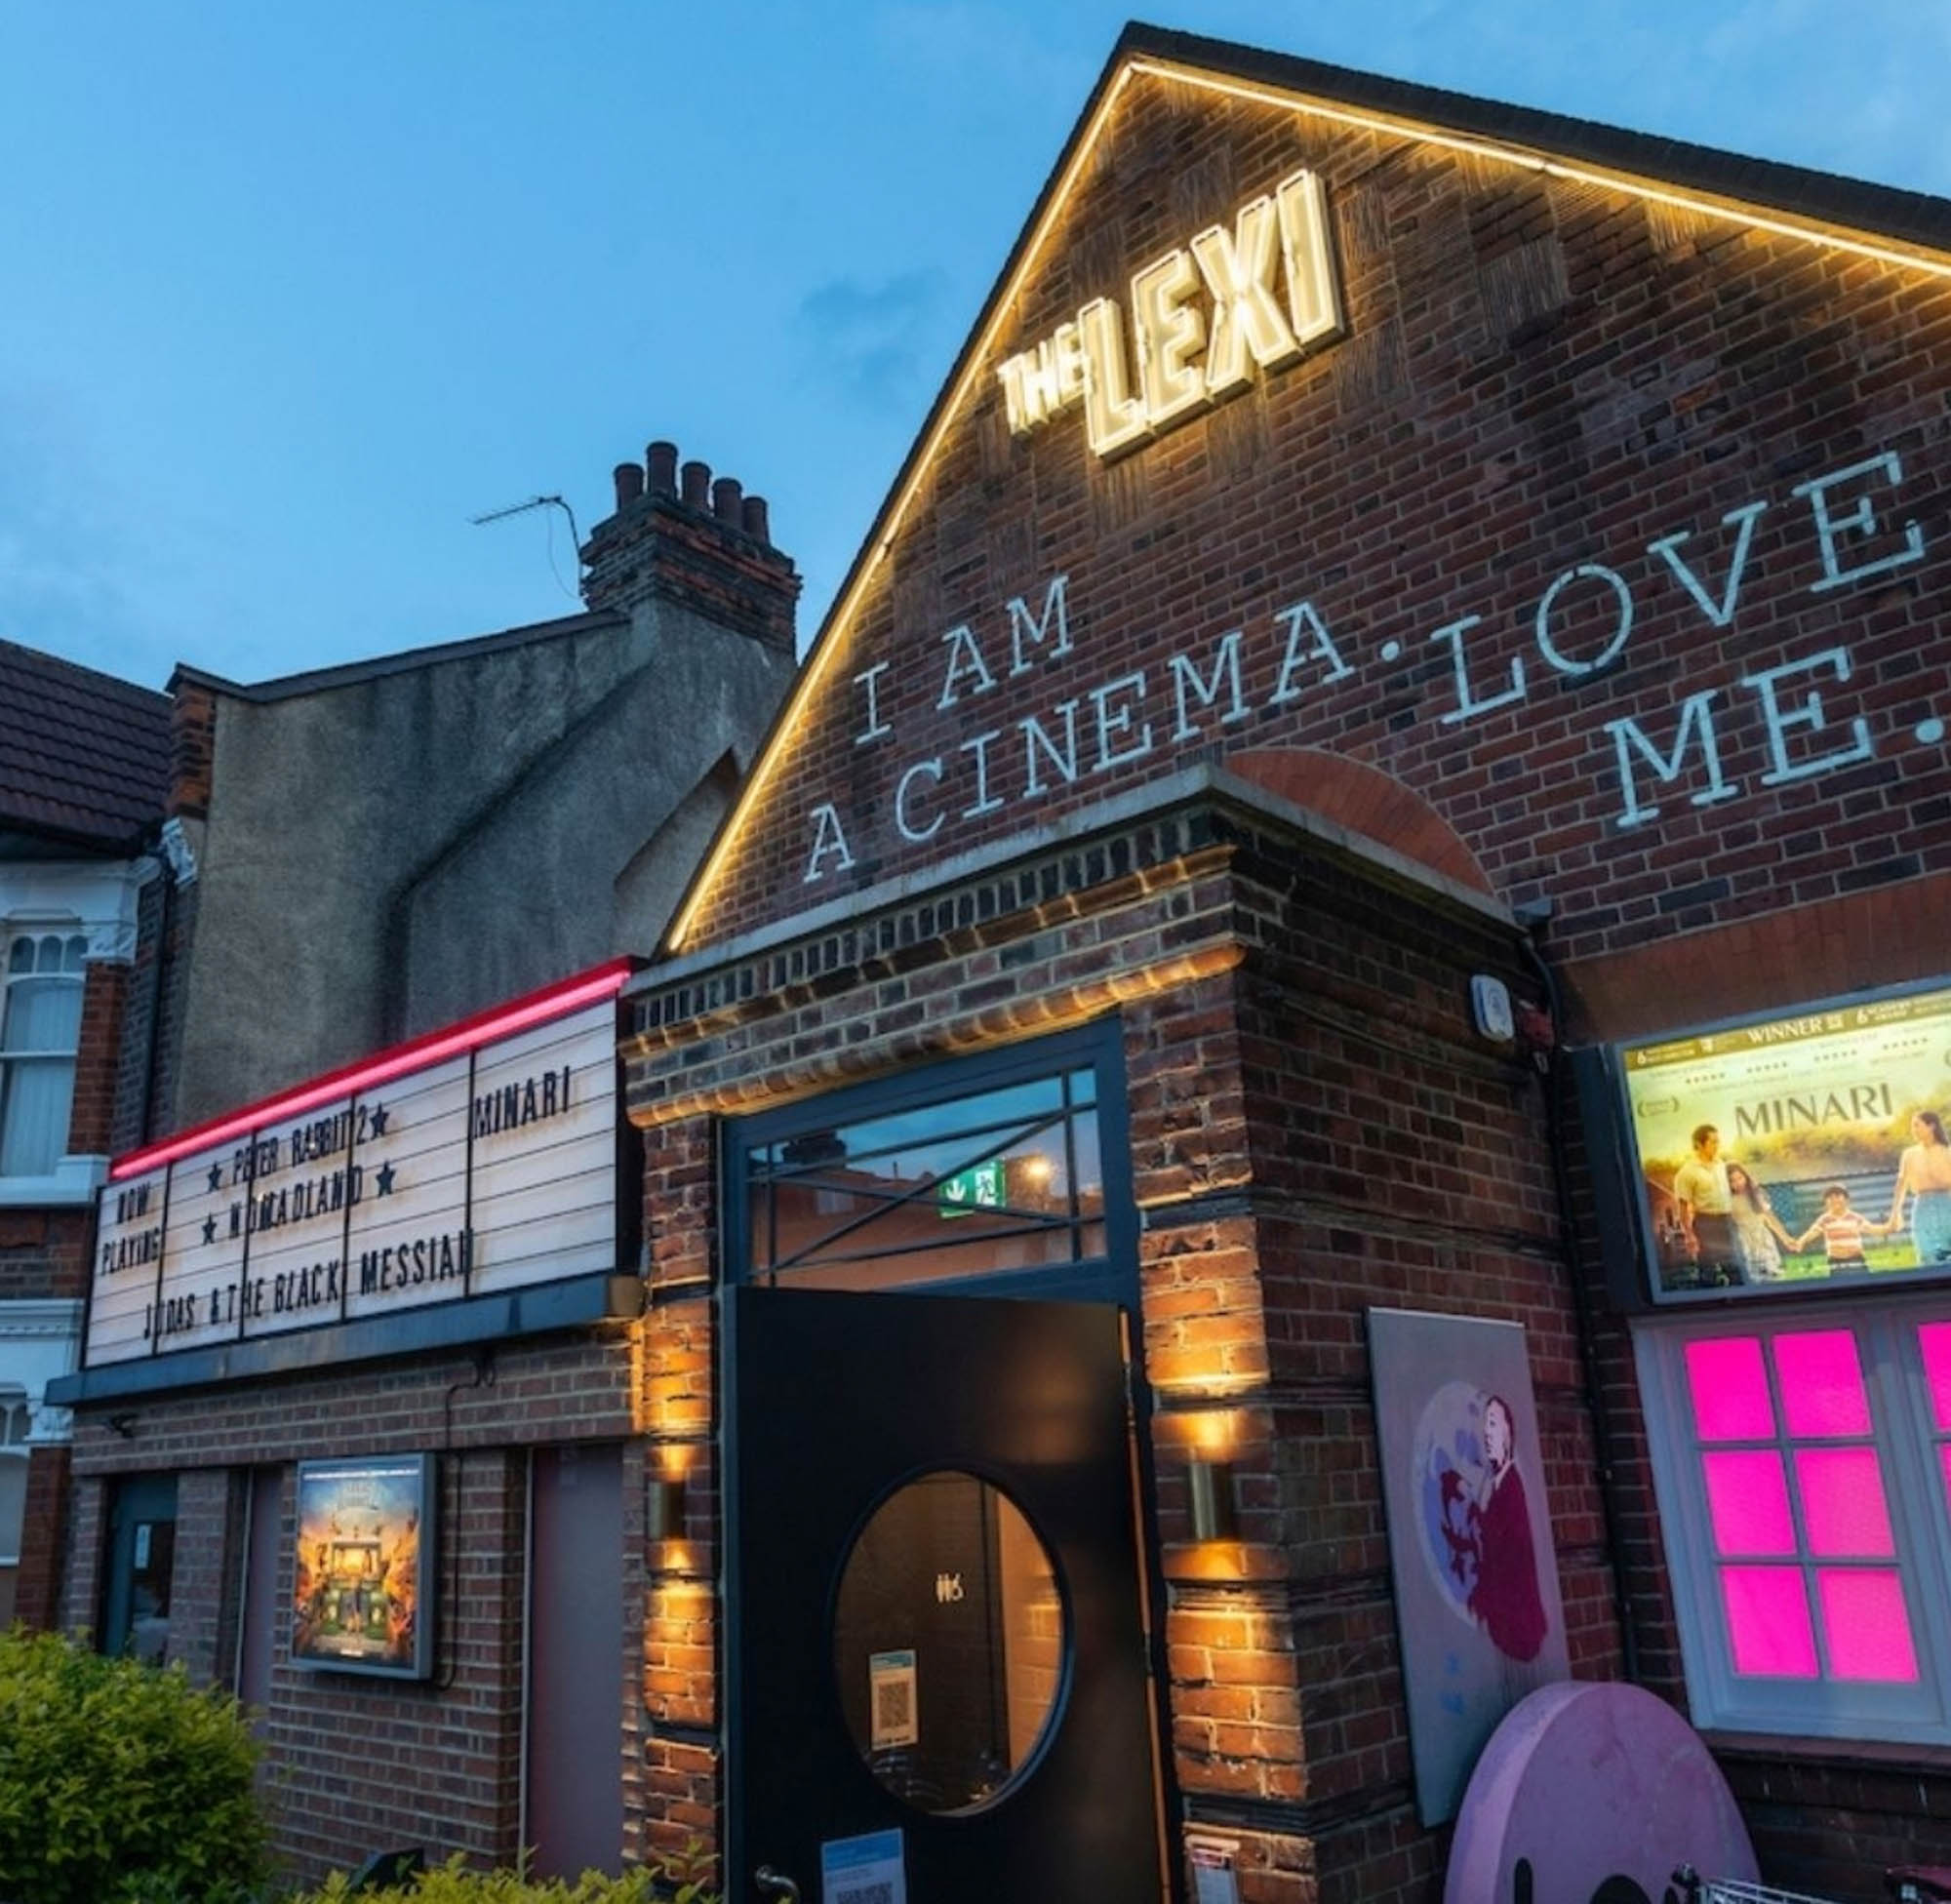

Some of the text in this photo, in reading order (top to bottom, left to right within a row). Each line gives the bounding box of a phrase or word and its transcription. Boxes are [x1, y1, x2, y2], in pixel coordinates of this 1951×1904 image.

[997, 168, 1344, 461] THE LEXI
[1429, 450, 1926, 725] LOVE
[853, 575, 1074, 745] I AM
[803, 802, 856, 884] A
[1747, 1015, 1824, 1044] WINNER
[473, 1064, 571, 1140] MINARI
[1734, 1082, 1894, 1137] MINARI
[231, 1135, 280, 1186] PETER
[355, 1104, 369, 1146] 2
[228, 1164, 364, 1240] NOMADLAND
[100, 1225, 161, 1277] PLAYING
[228, 1276, 266, 1324] THE
[273, 1258, 340, 1313] BLACK
